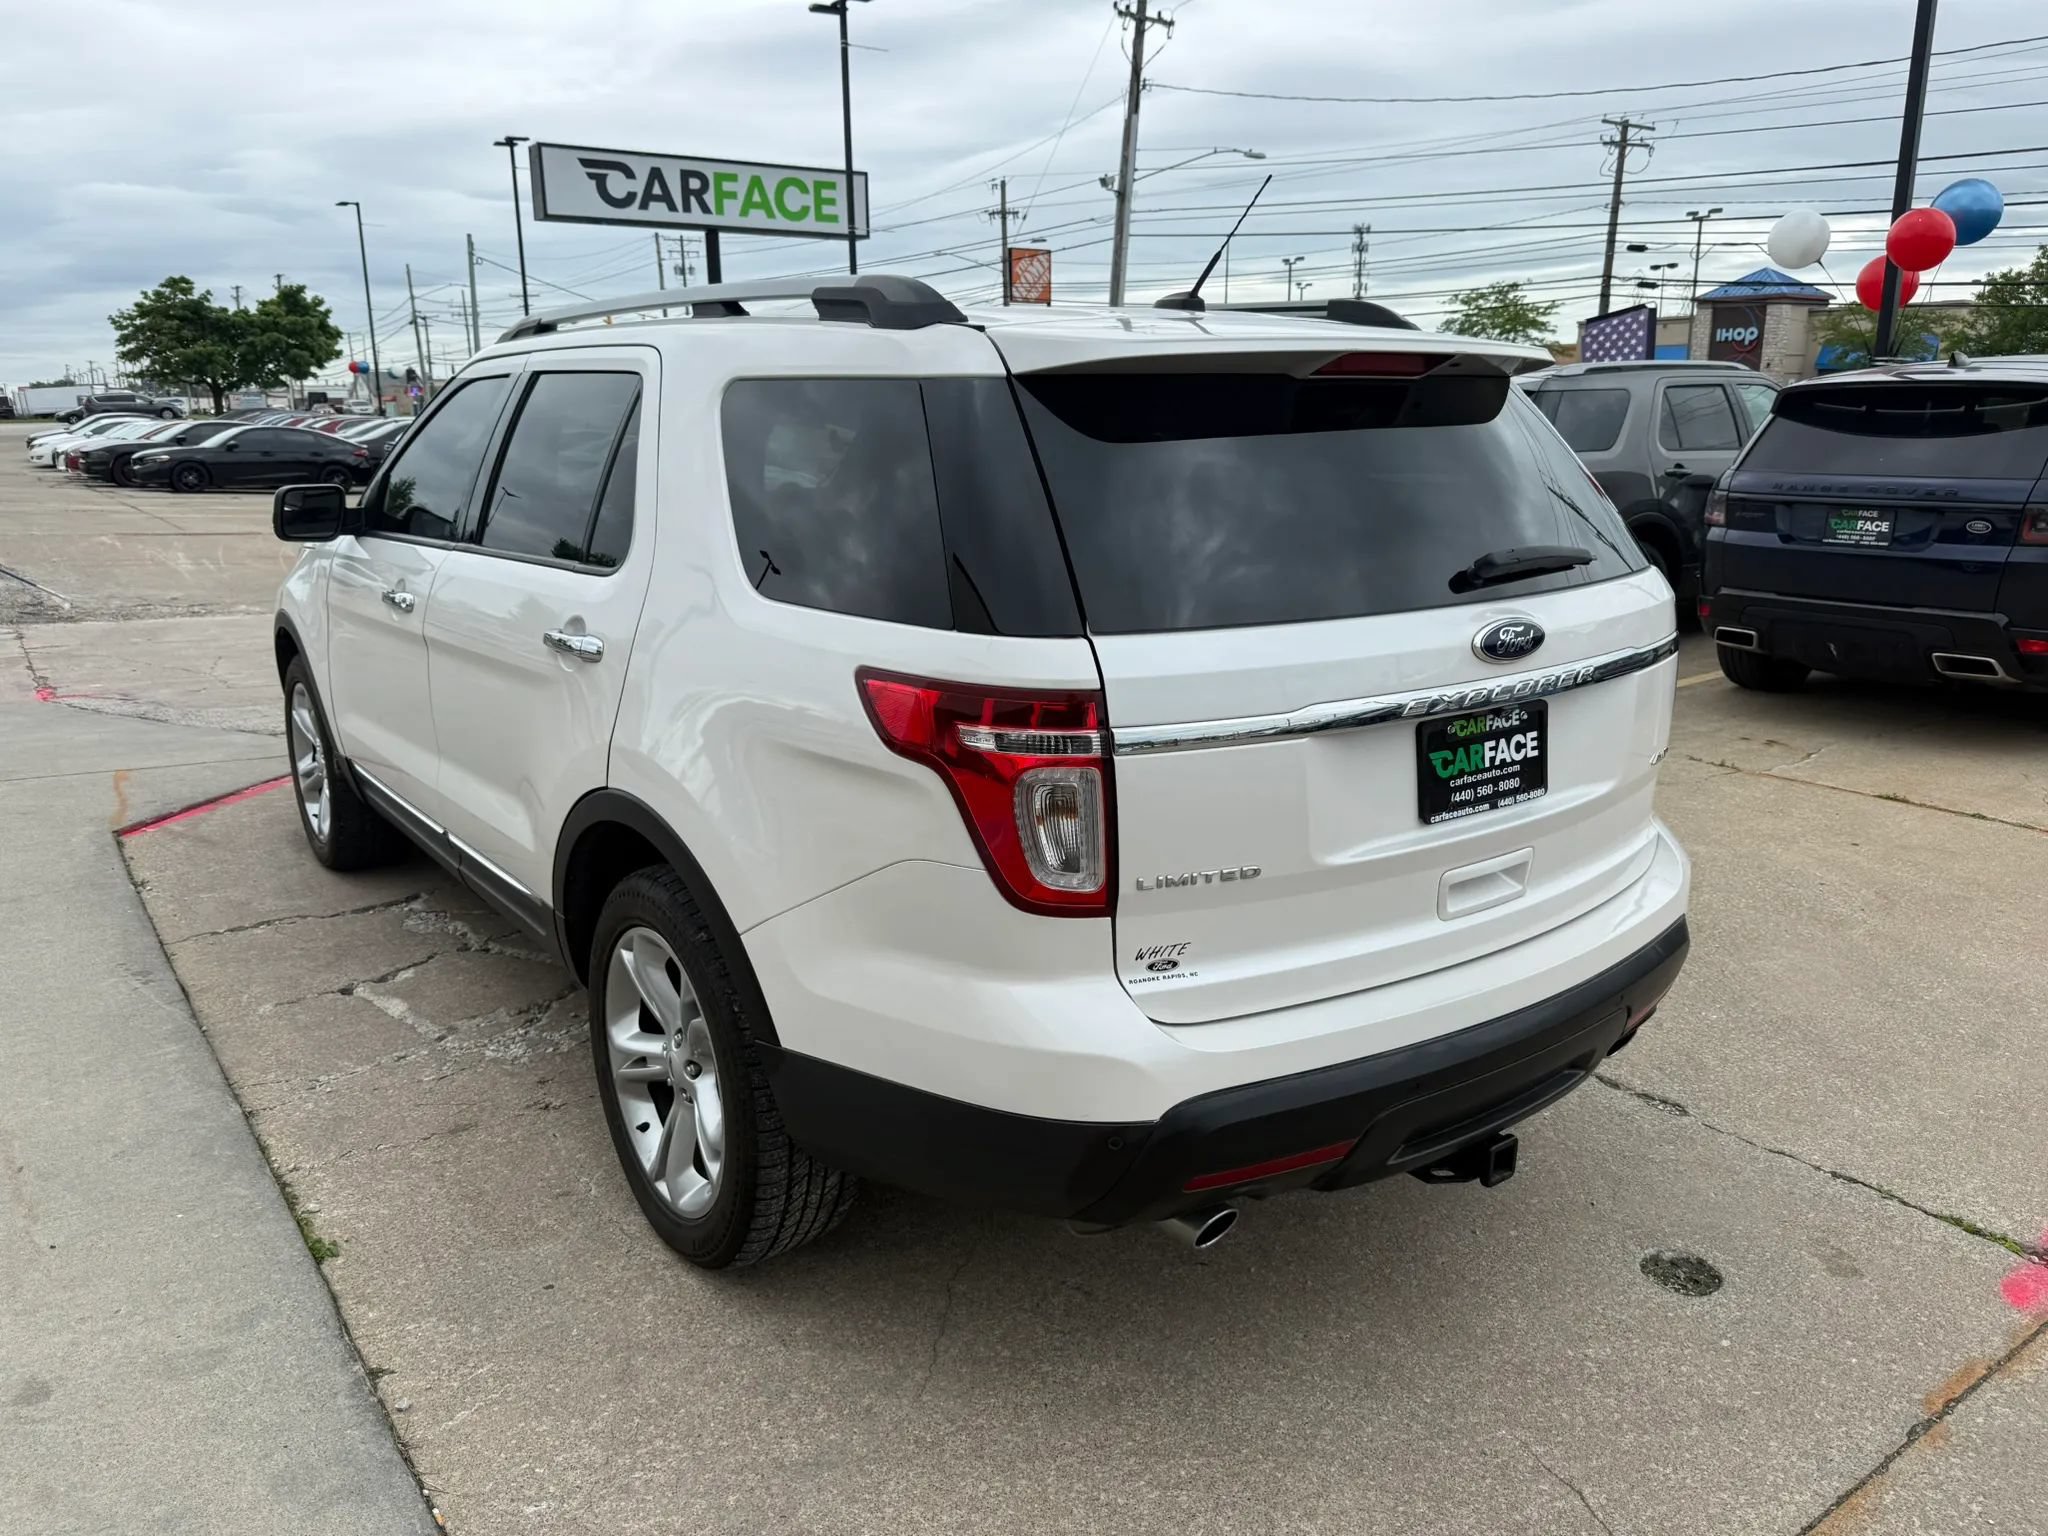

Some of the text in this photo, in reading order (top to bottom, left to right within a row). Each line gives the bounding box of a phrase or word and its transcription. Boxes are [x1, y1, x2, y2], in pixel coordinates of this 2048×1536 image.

[577, 157, 839, 223] CARFACE
[1830, 519, 1890, 532] CARFACE
[1496, 625, 1534, 654] Ford
[1401, 664, 1596, 717] EXPLORER
[1453, 709, 1520, 737] CARFACE
[1429, 731, 1539, 778] CARFACE
[1449, 764, 1521, 787] carfaceauto.com
[1430, 787, 1546, 824] carfaceauto.com (440) 560-8080
[1451, 788, 1475, 803] (440)
[1136, 865, 1262, 891] LIMITED
[1135, 942, 1191, 961] WHITE
[1129, 976, 1161, 984] ROANOKE
